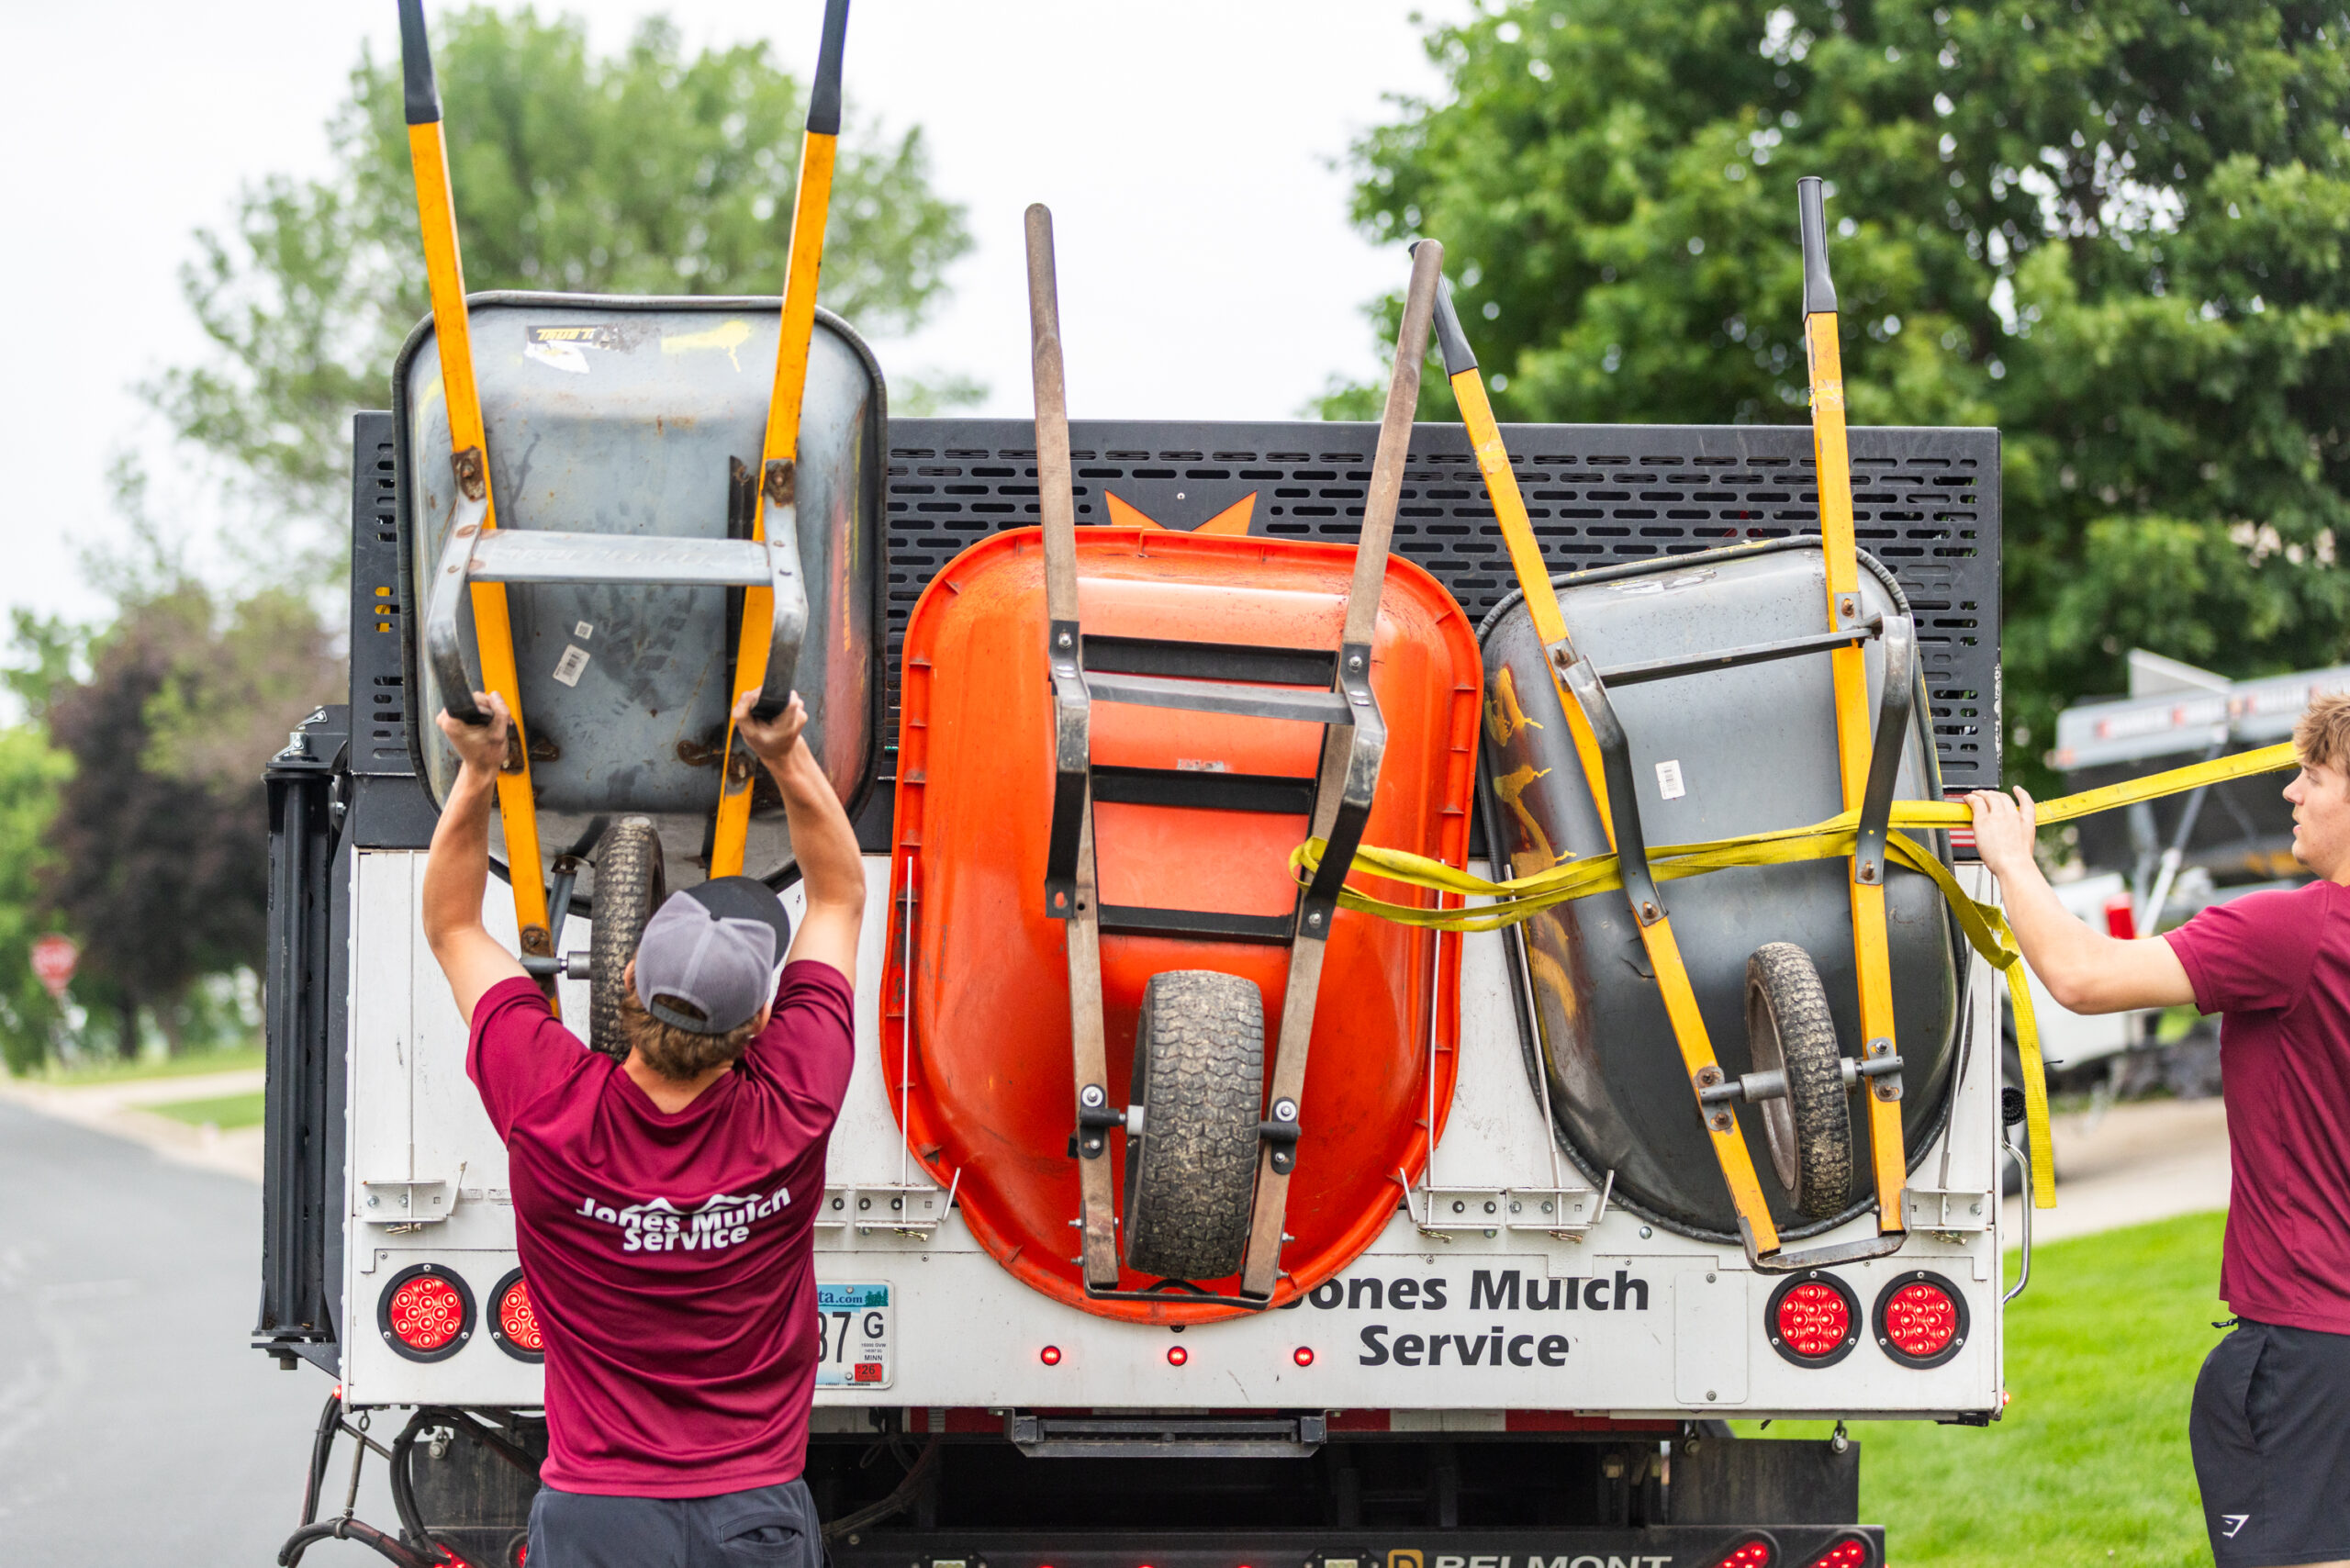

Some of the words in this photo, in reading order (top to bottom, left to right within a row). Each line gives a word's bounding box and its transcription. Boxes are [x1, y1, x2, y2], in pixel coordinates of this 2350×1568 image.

[576, 1197, 681, 1232] Jones
[691, 1187, 791, 1231] Mulch
[622, 1226, 750, 1251] Service
[1278, 1275, 1448, 1311] ones
[1469, 1270, 1650, 1311] Mulch
[864, 1311, 884, 1338] G
[1359, 1325, 1570, 1367] Service
[861, 1364, 876, 1375] 26
